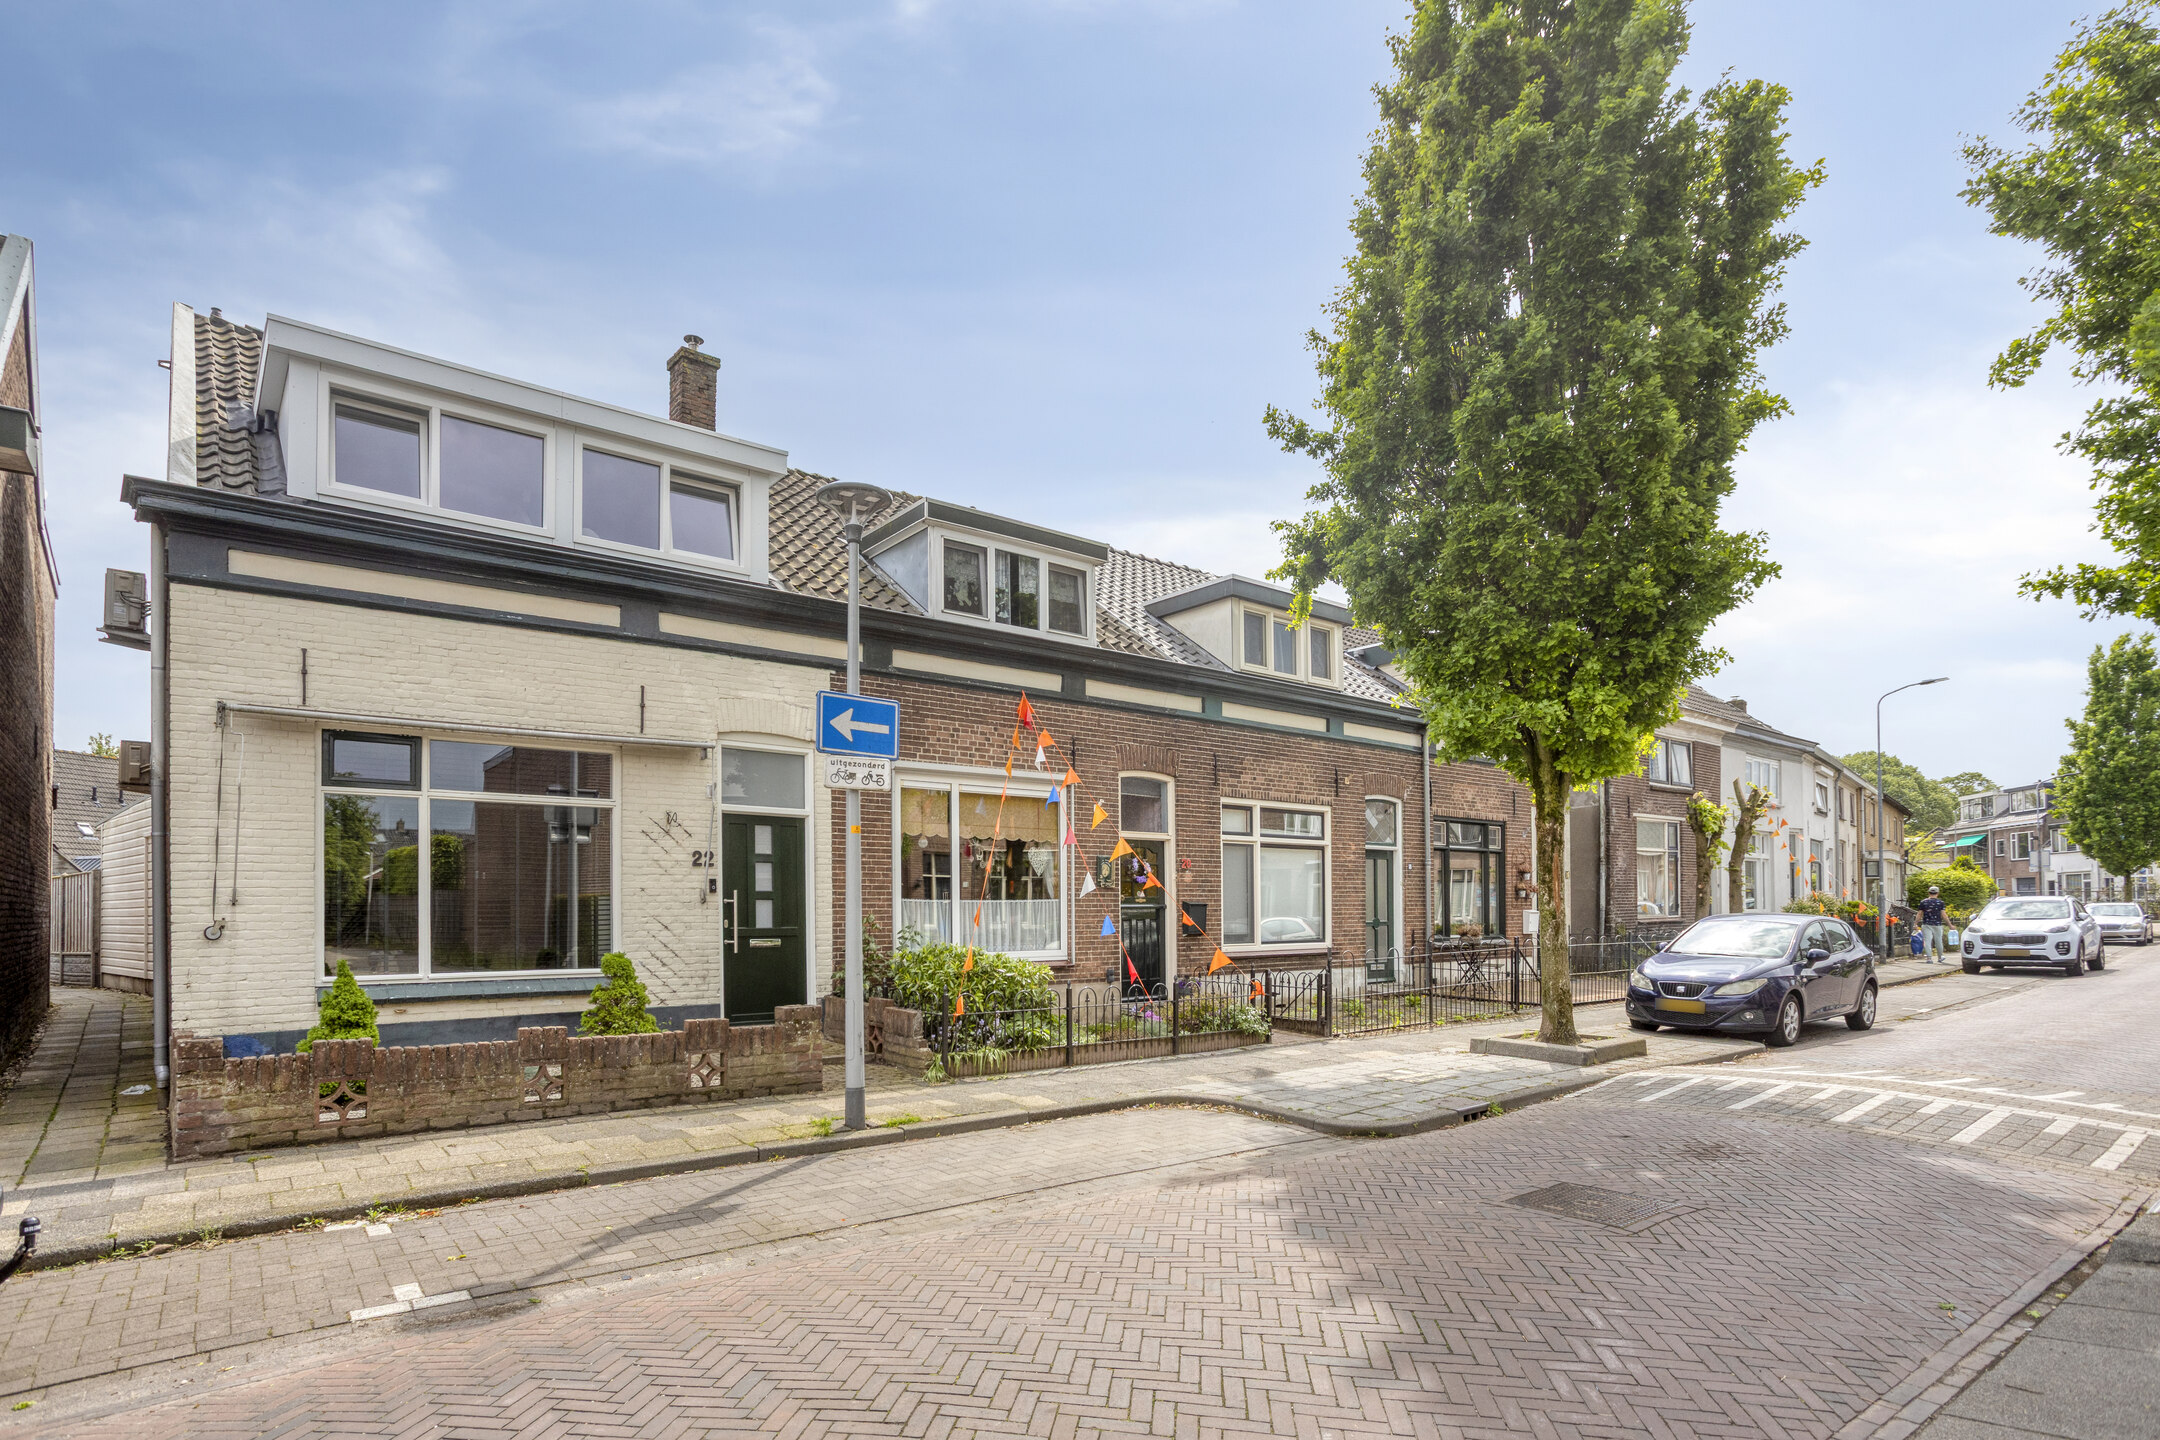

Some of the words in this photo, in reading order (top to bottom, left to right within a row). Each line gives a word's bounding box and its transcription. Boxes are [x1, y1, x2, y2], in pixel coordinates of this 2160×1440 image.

[830, 759, 885, 770] uitgezonderd
[692, 850, 714, 867] 22
[1181, 858, 1192, 869] 20
